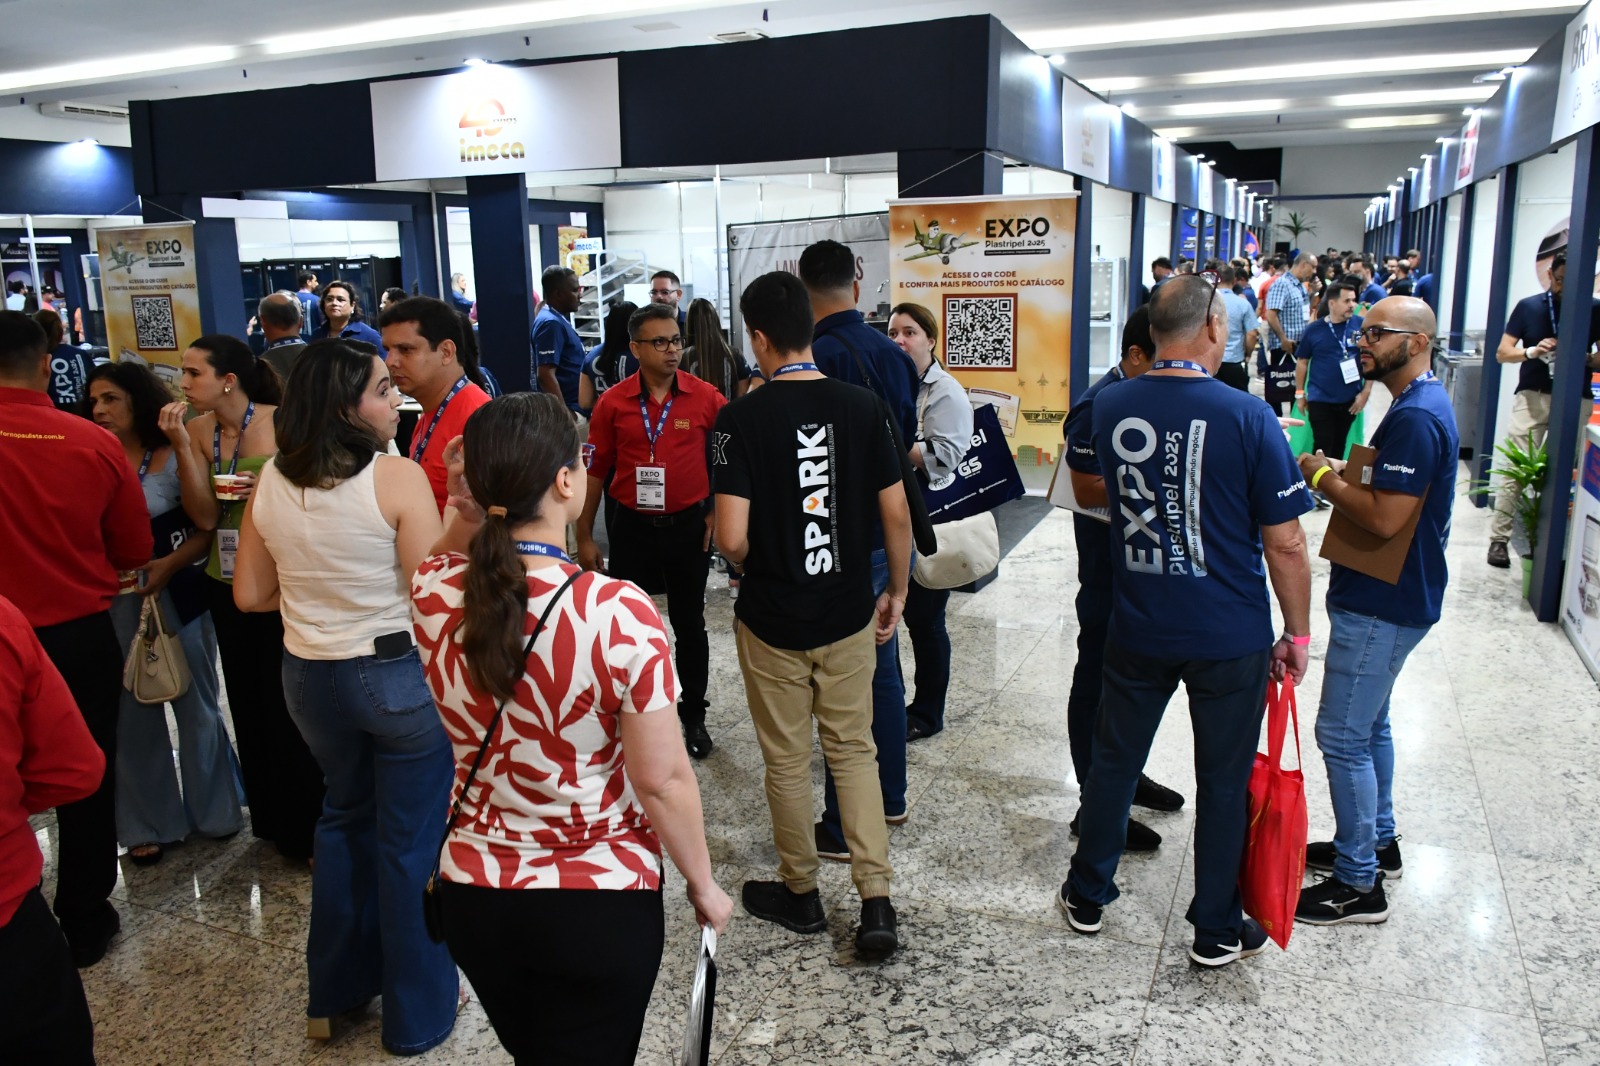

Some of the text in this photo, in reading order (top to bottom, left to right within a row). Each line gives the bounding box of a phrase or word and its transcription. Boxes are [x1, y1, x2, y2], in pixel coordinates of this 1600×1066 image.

[459, 138, 525, 162] imeca
[985, 217, 1050, 238] EXPO
[146, 240, 182, 255] EXPO
[985, 240, 1025, 248] Plastripel
[981, 271, 993, 279] QR
[1020, 278, 1065, 286] CATÁLOGO
[1191, 425, 1201, 457] negócios
[957, 456, 983, 477] GS
[1383, 463, 1415, 475] Plastripel
[797, 425, 833, 576] SPARK
[1112, 417, 1163, 575] EXPO
[1162, 431, 1188, 576] Plastripel 2025
[516, 542, 547, 554] Plastrip
